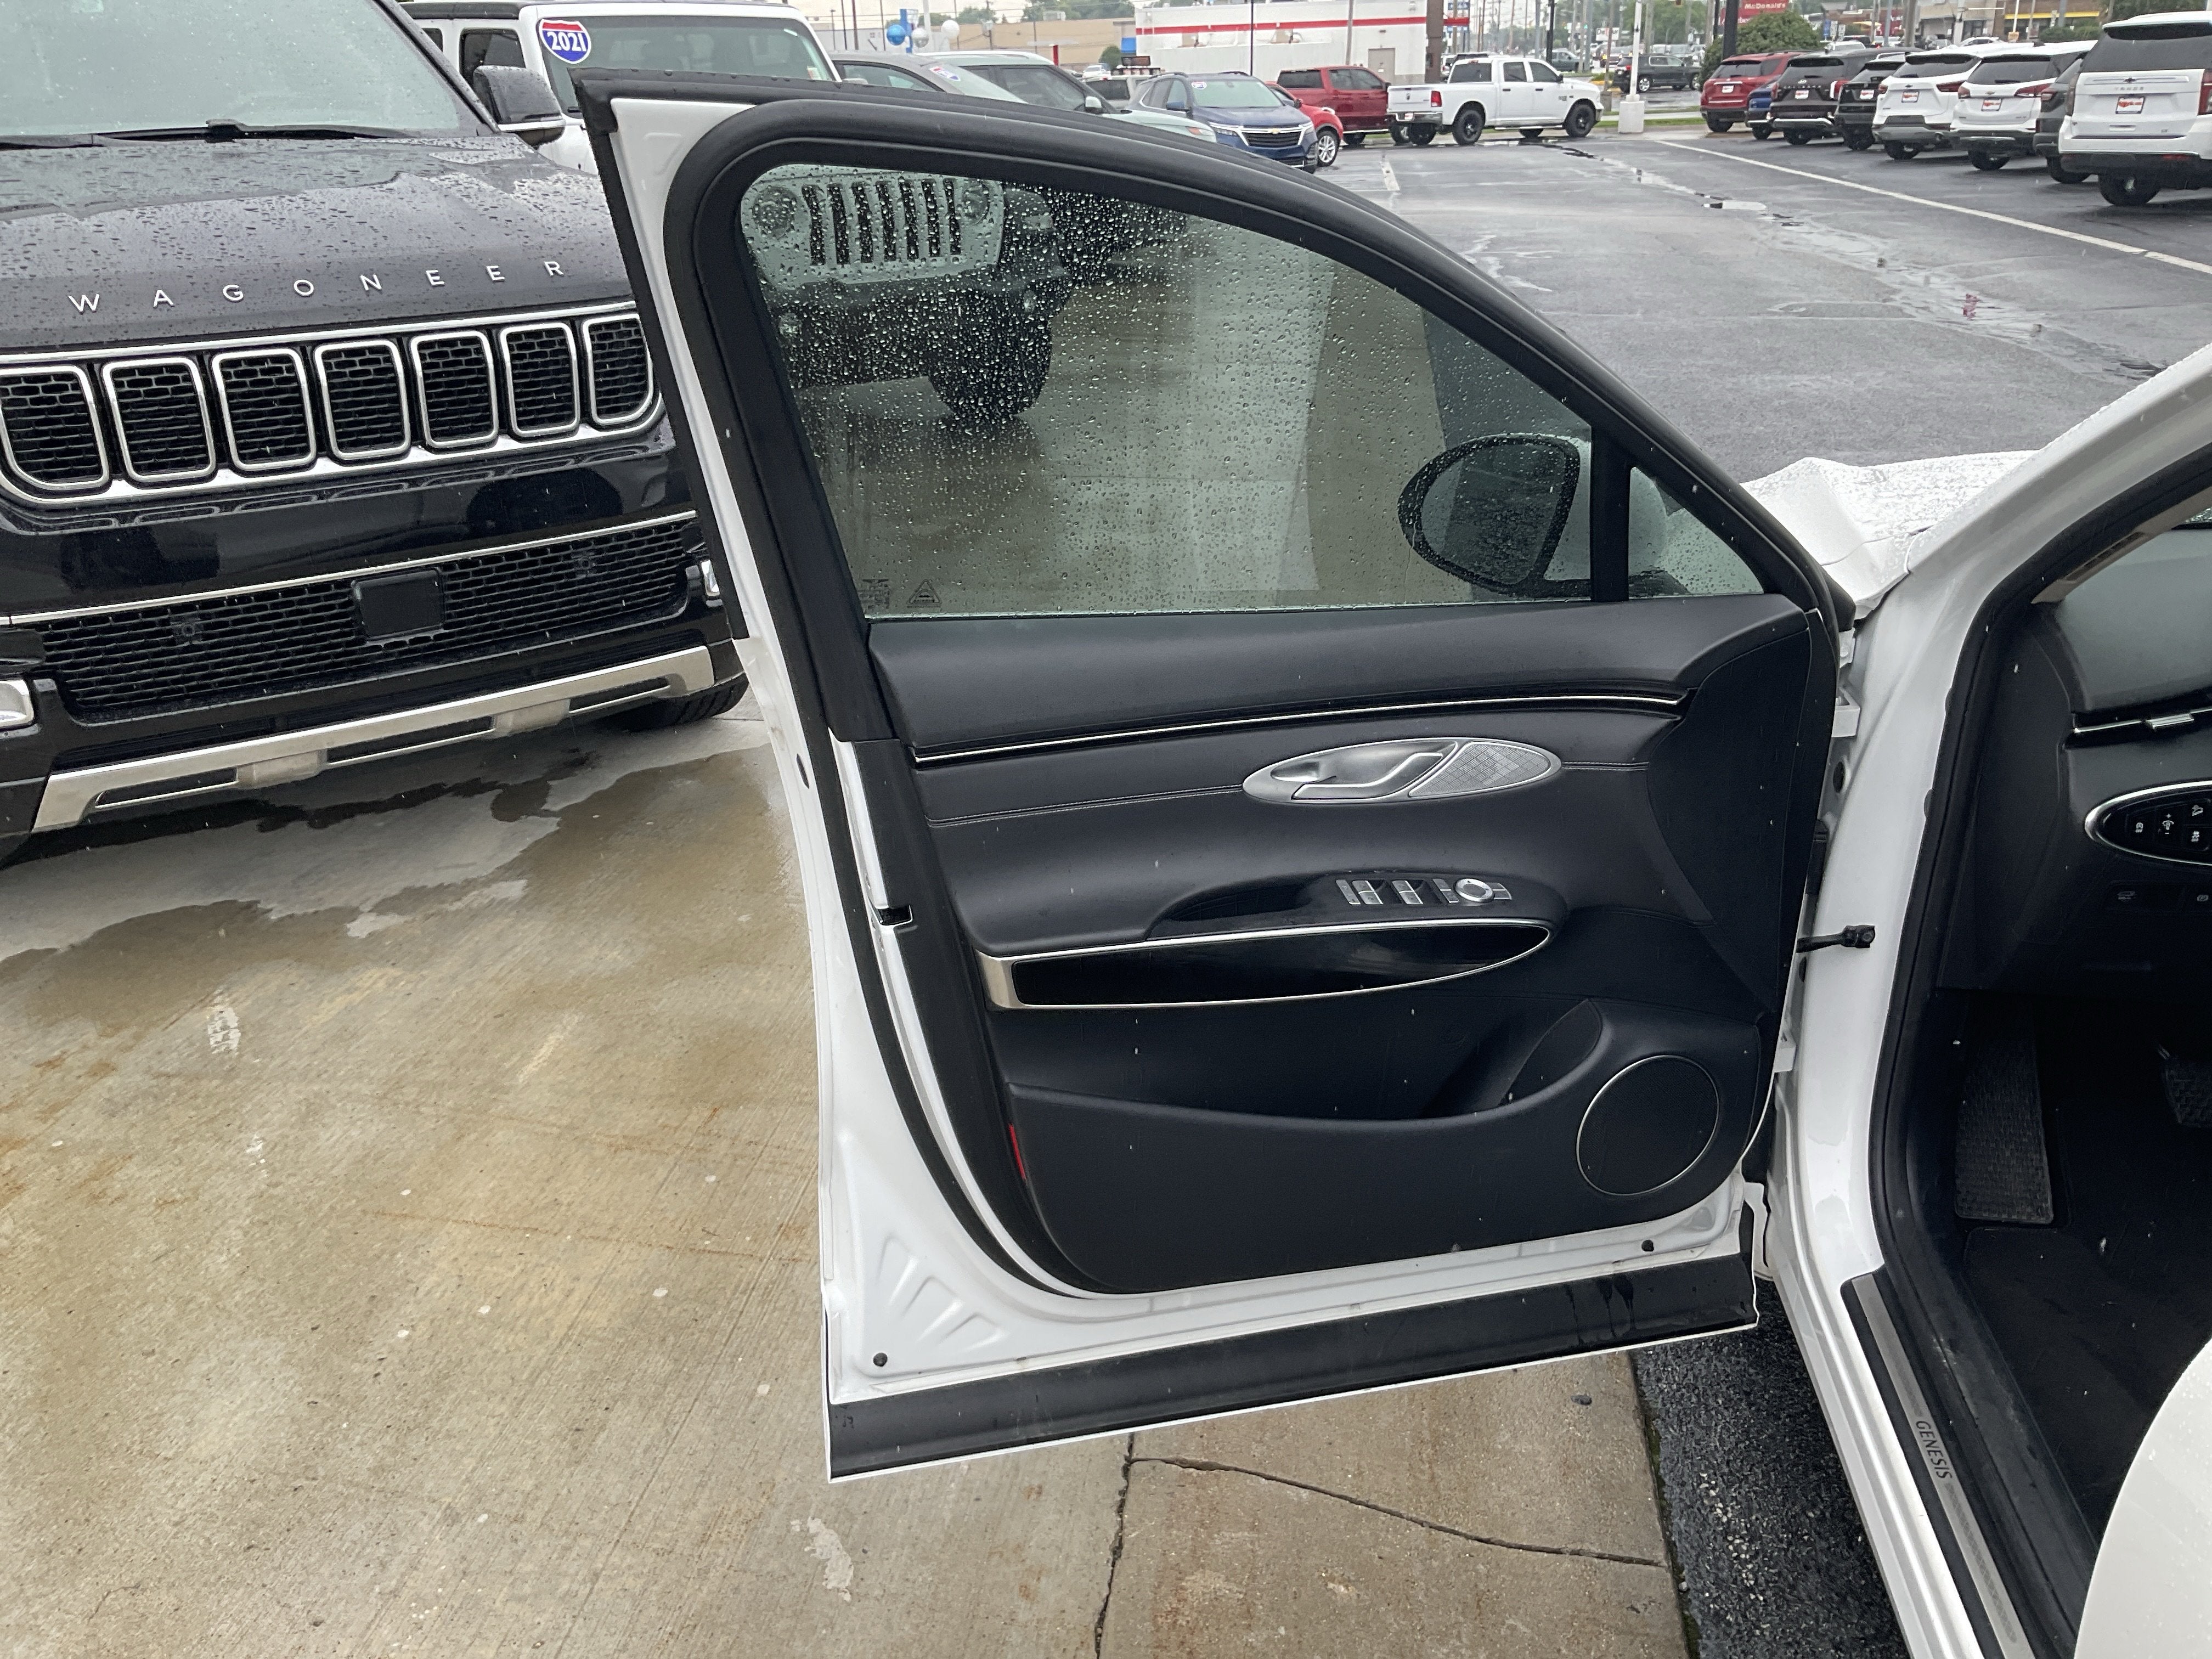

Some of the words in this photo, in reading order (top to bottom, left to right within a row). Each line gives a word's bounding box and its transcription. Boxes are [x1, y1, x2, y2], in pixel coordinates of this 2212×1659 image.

[547, 31, 586, 52] 2021
[69, 261, 565, 313] WAGONEER
[1916, 1421, 1953, 1479] GENESIS
